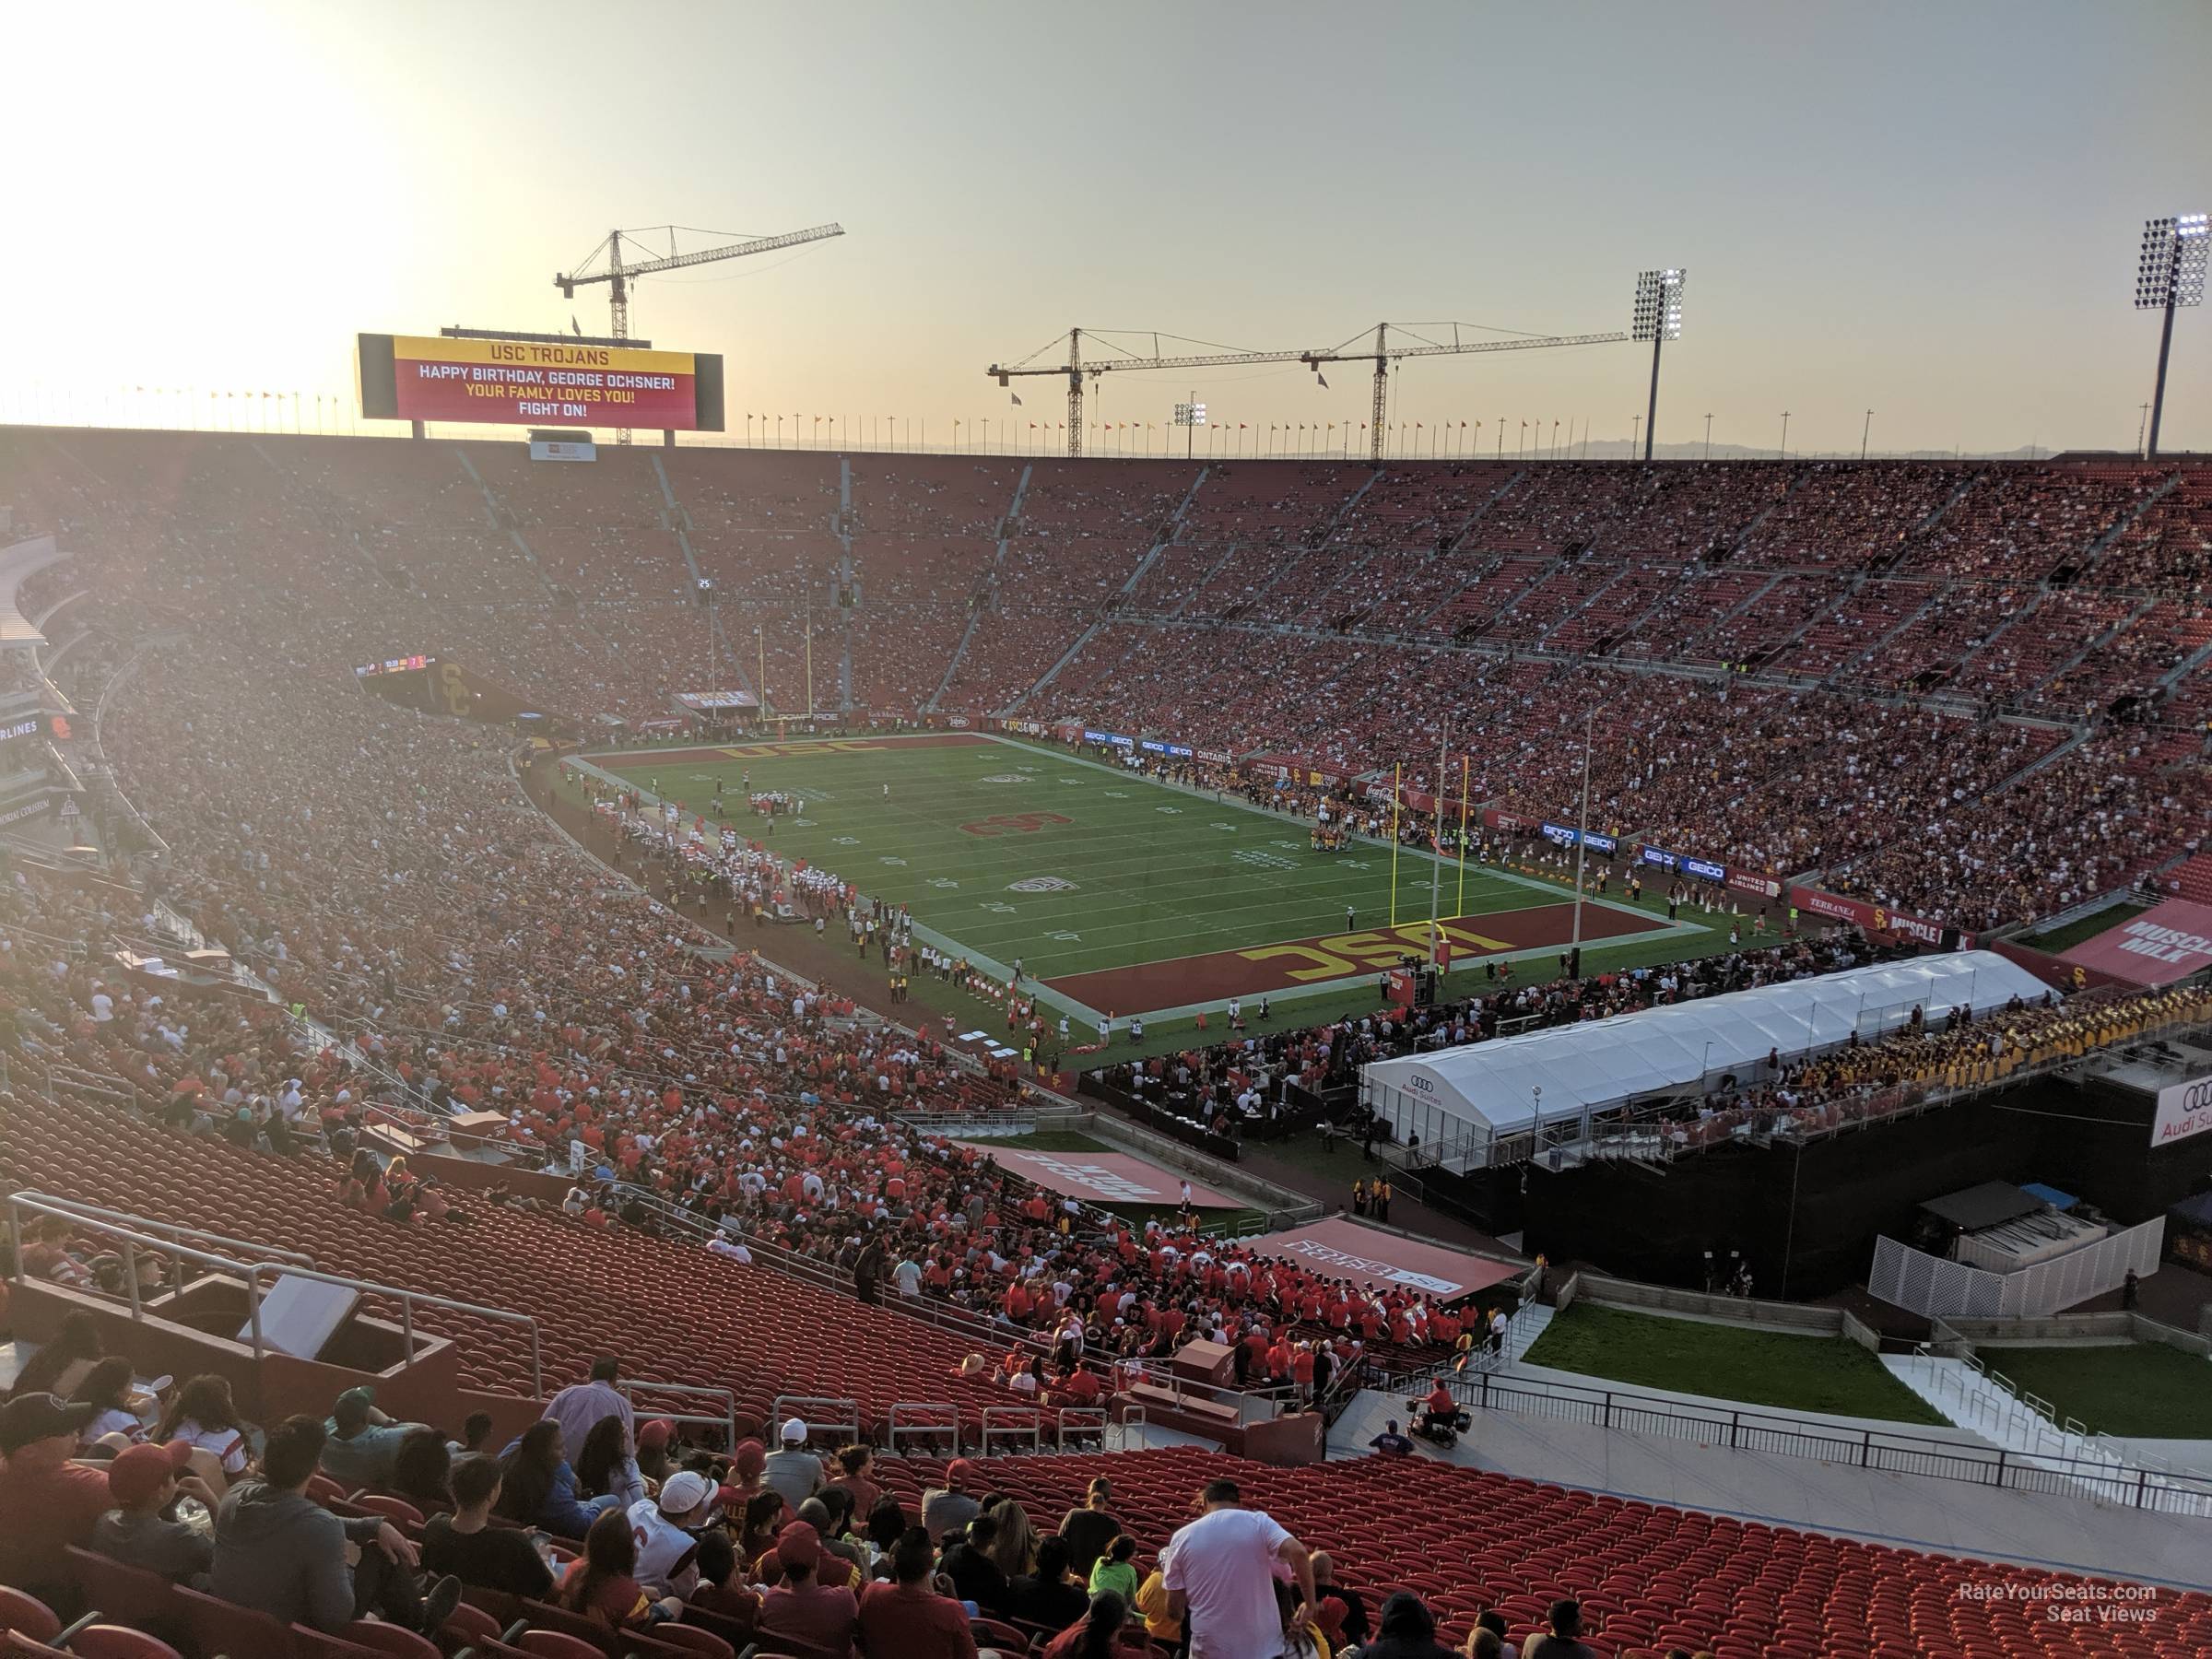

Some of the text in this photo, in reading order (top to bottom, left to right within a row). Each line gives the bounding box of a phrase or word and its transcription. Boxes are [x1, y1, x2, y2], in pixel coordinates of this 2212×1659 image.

[491, 345, 609, 366] USC TROJANS
[419, 365, 676, 390] HAPPY BIRTHDAY, GEORGE OCHSNER!
[465, 383, 635, 404] YOUR FAMLY LOVES YOU!
[519, 402, 587, 418] FIGHT ON!
[680, 691, 750, 701] MUSCLE
[700, 700, 744, 708] MILK
[1085, 731, 1106, 741] GEICO
[1112, 735, 1133, 747] GEICO
[716, 741, 889, 759] USC
[1142, 741, 1193, 757] GEICO GEICO
[1256, 762, 1278, 771] UNITED
[1544, 825, 1574, 840] GEICO
[1688, 861, 1724, 878] GEICO
[1728, 878, 1765, 893] AIRLINES
[1736, 874, 1766, 886] UNITED
[1236, 922, 1519, 982] USC
[2117, 937, 2193, 963] MILK
[1402, 1083, 1418, 1096] Audi
[2161, 1115, 2195, 1140] Audi
[1393, 1273, 1453, 1291] USC
